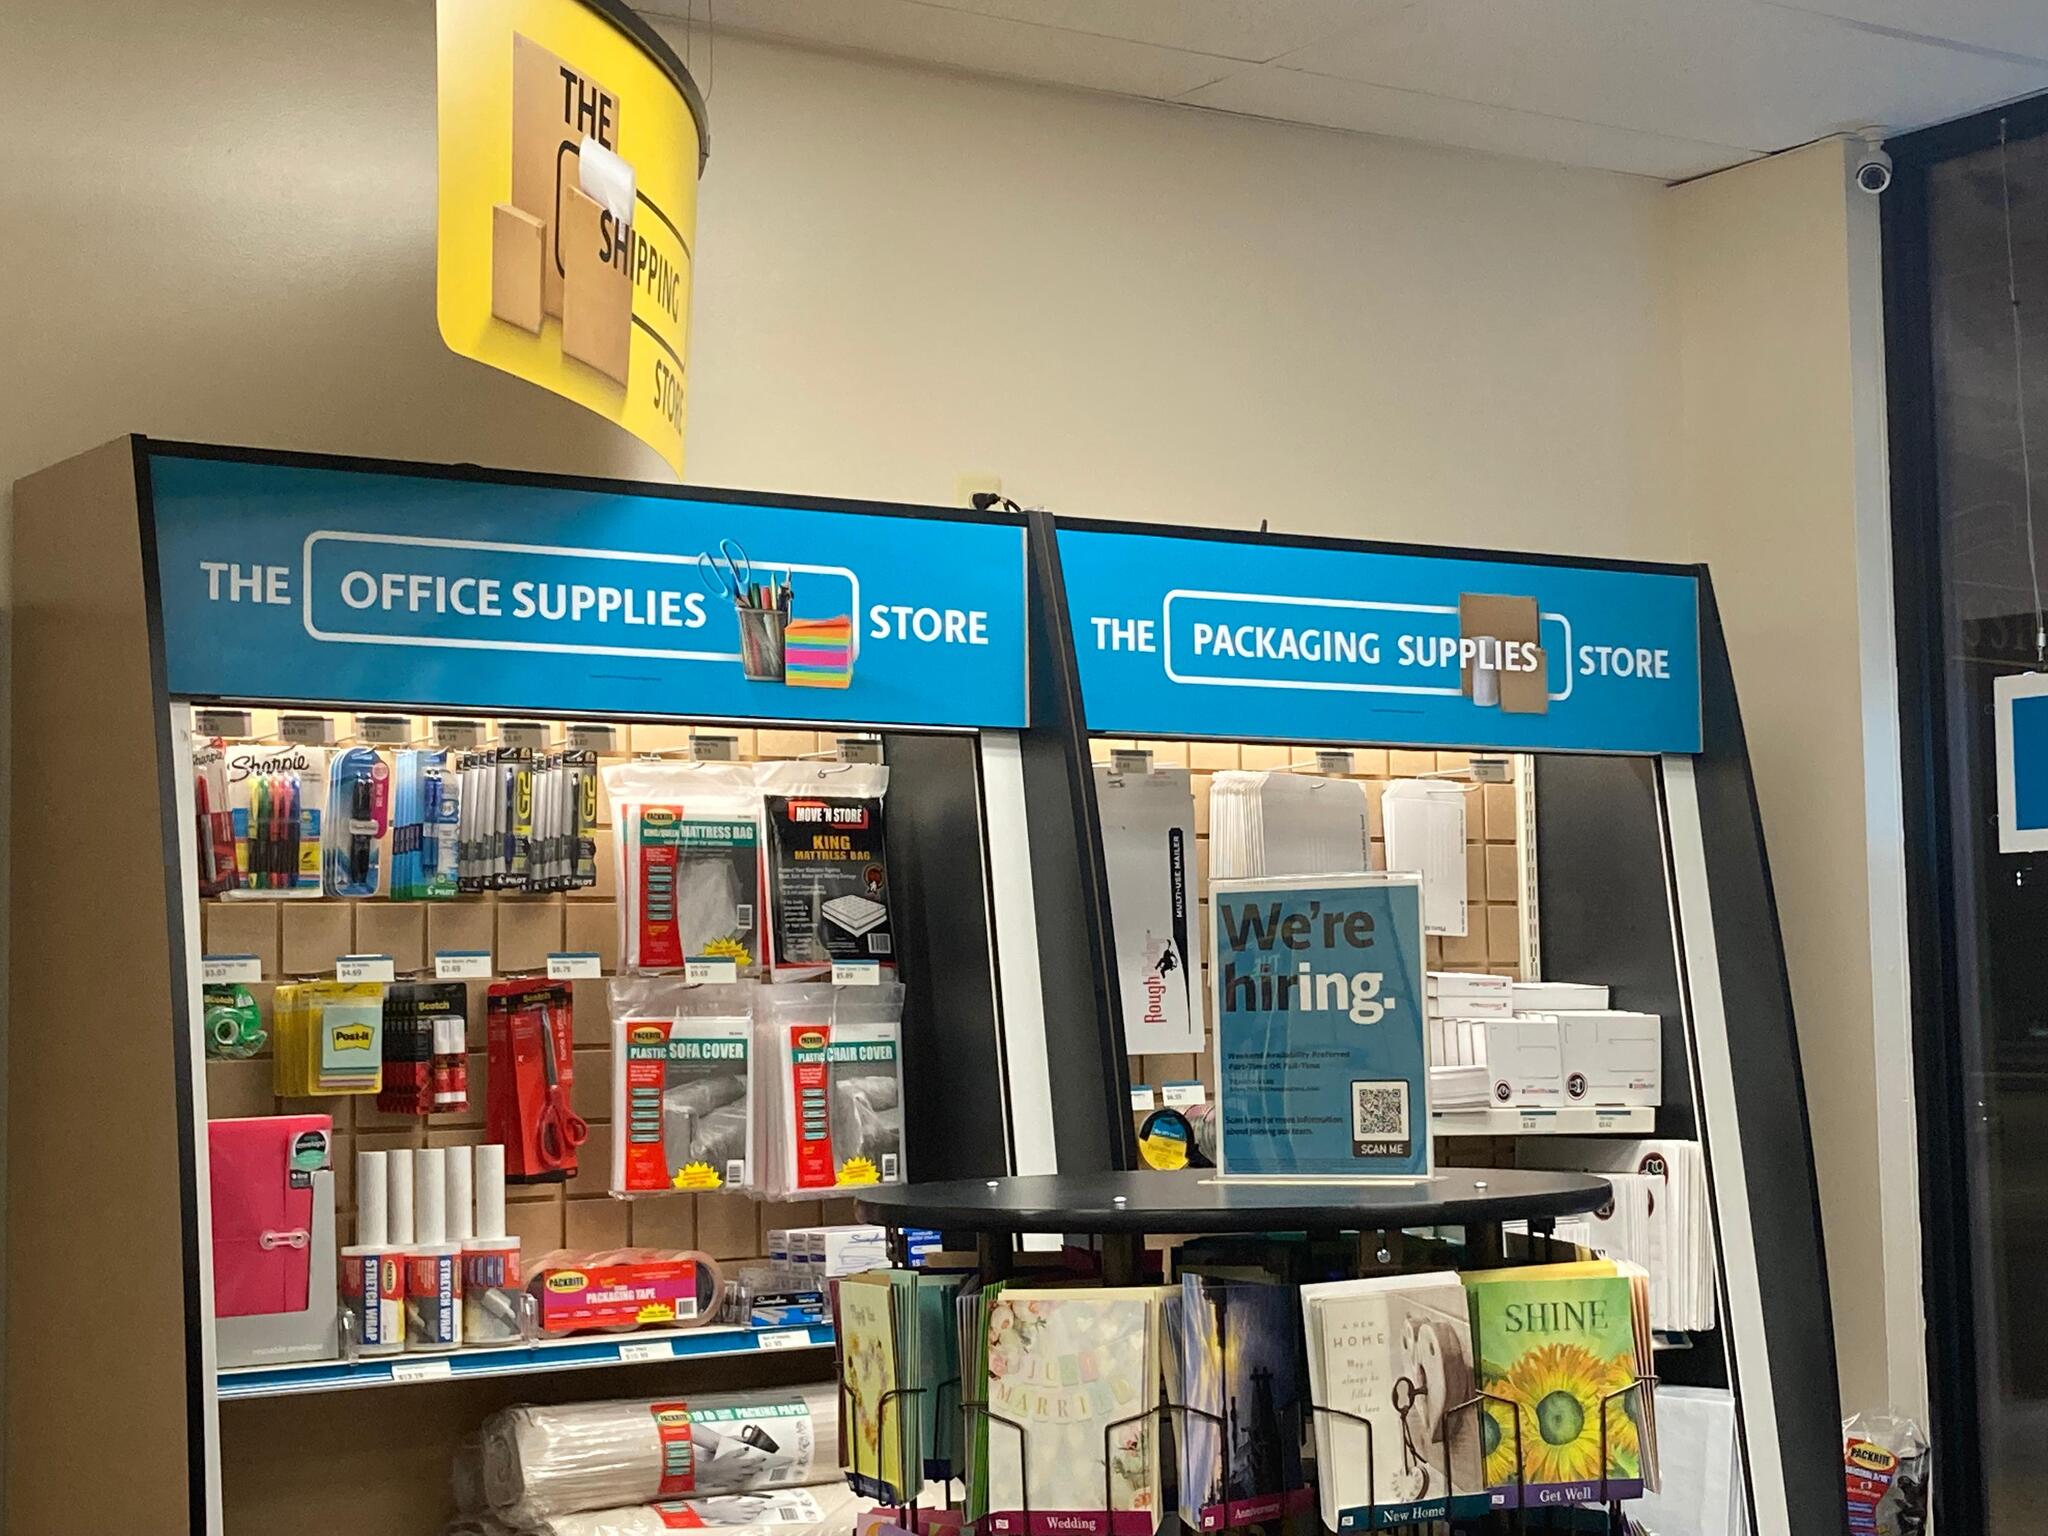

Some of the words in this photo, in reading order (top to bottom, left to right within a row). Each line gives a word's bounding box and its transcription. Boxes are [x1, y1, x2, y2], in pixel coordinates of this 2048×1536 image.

[560, 66, 612, 152] THE
[599, 209, 681, 324] SHIPPING
[654, 358, 685, 437] STORE
[201, 561, 291, 605] THE
[340, 570, 502, 616] OFFICE
[512, 582, 707, 628] SUPPLIES
[870, 604, 989, 645] STORE
[1091, 617, 1156, 653] THE
[1193, 622, 1381, 665] PACKAGING
[1397, 634, 1539, 672] SUPPLIES
[1579, 645, 1671, 679] STORE
[230, 752, 310, 783] Sharpie
[796, 807, 822, 823] MOVE
[833, 807, 863, 823] STORE
[681, 824, 731, 840] MATTRESS
[732, 826, 753, 840] BAG
[812, 835, 851, 850] KING
[794, 850, 848, 862] MATTRESS
[850, 851, 871, 861] BAG
[1172, 836, 1181, 869] MAILER
[505, 877, 527, 885] PILOT
[572, 879, 594, 887] PILOT
[1220, 901, 1375, 951] We're
[523, 992, 551, 1003] Scotch
[1143, 976, 1167, 1024] Rough
[1224, 961, 1396, 1025] hiring.
[418, 1001, 450, 1011] Scotch
[336, 1031, 369, 1041] Post-it
[630, 1047, 667, 1059] PLASTIC
[669, 1043, 700, 1059] SOFA
[702, 1043, 744, 1059] COVER
[798, 1051, 825, 1062] PLASTIC
[826, 1047, 858, 1062] CHAIR
[859, 1046, 893, 1060] COVER
[1361, 1144, 1387, 1154] SCAN
[1388, 1144, 1404, 1153] ME
[365, 1260, 378, 1307] STRETCH
[440, 1260, 451, 1307] STRETCH
[549, 1276, 585, 1288] PACKRITE
[586, 1289, 635, 1304] PACKAGING
[635, 1287, 656, 1300] TAPE
[366, 1308, 378, 1341] WRAP
[440, 1308, 452, 1340] WRAP
[1505, 1301, 1609, 1333] SHINE
[1333, 1333, 1384, 1347] HOME
[735, 1406, 778, 1419] PACKING
[779, 1404, 808, 1415] PAPER
[1540, 1489, 1561, 1503] Get
[1565, 1487, 1592, 1500] Well
[1047, 1517, 1096, 1532] Wedding
[1383, 1510, 1411, 1523] New
[1412, 1505, 1446, 1520] Home
